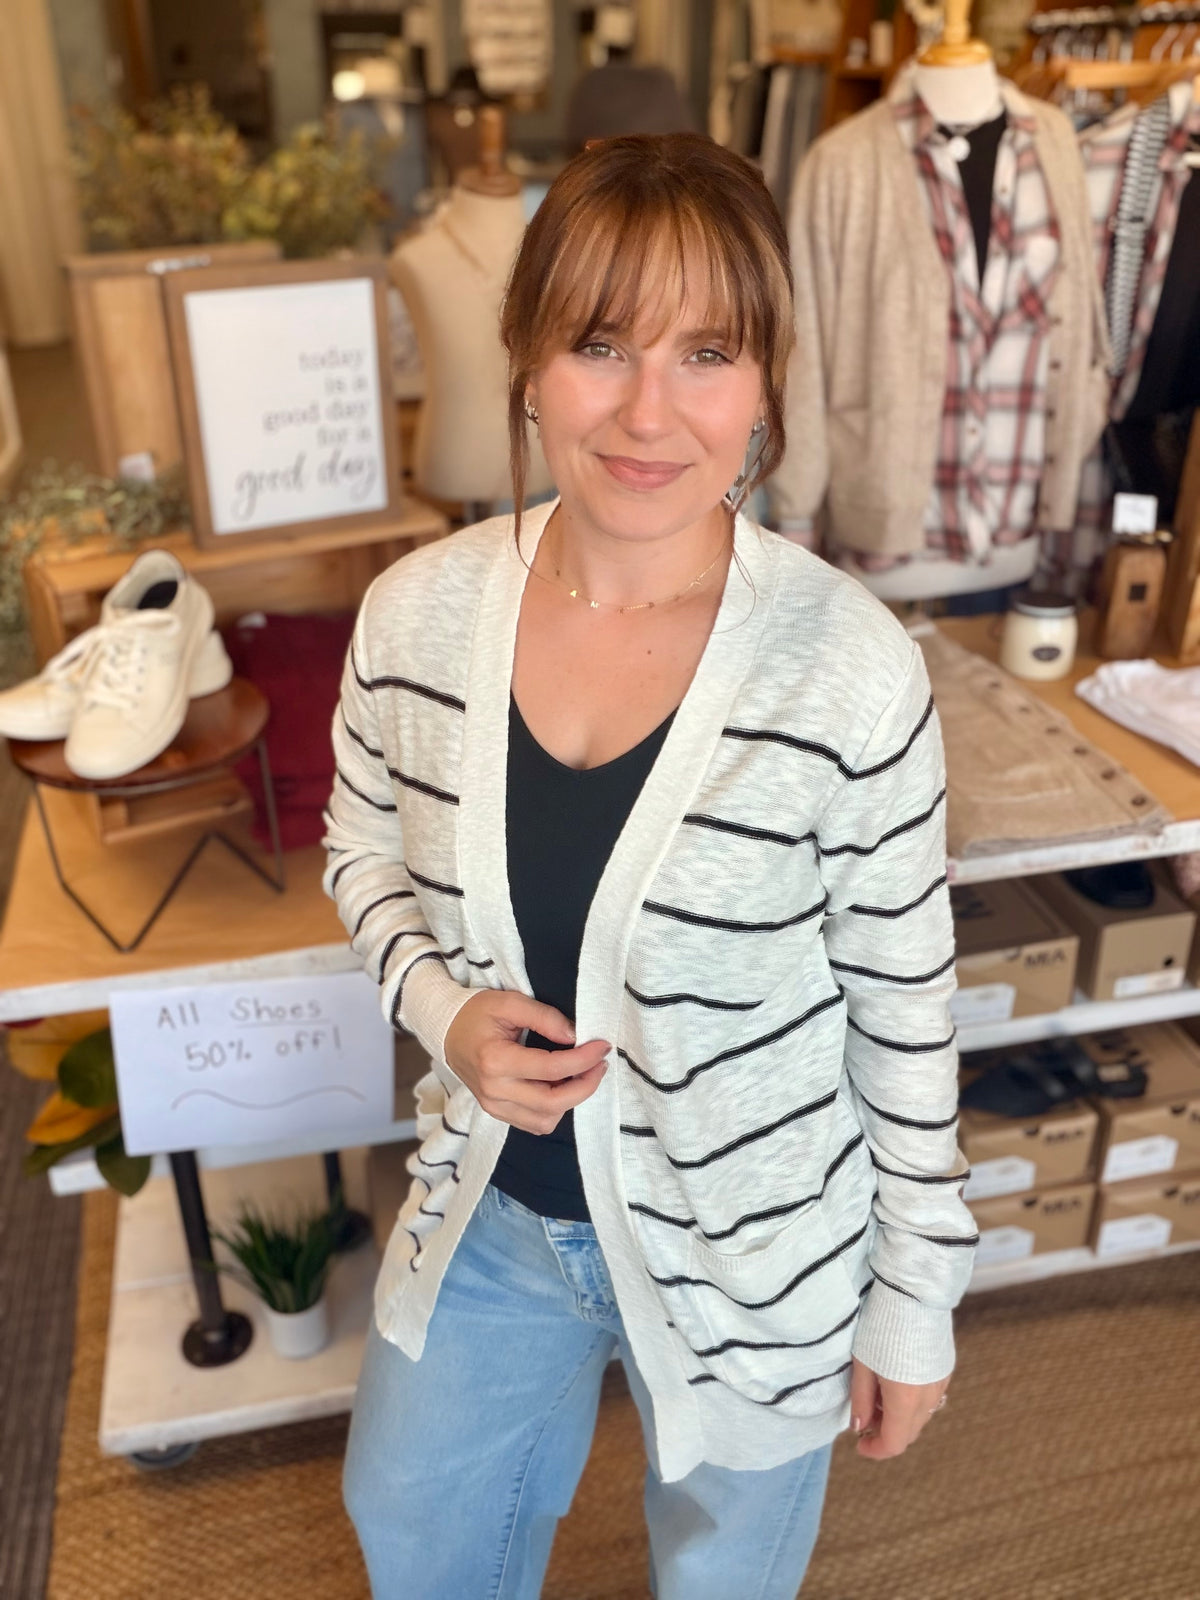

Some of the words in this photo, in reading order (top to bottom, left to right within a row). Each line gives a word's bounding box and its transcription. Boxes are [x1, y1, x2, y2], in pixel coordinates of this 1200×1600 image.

[299, 347, 364, 371] today
[262, 402, 320, 434] good
[326, 400, 368, 421] day
[232, 451, 307, 520] good
[317, 449, 377, 500] day
[157, 1001, 199, 1030] All
[230, 997, 323, 1022] Shoes
[185, 1039, 252, 1072] 50%
